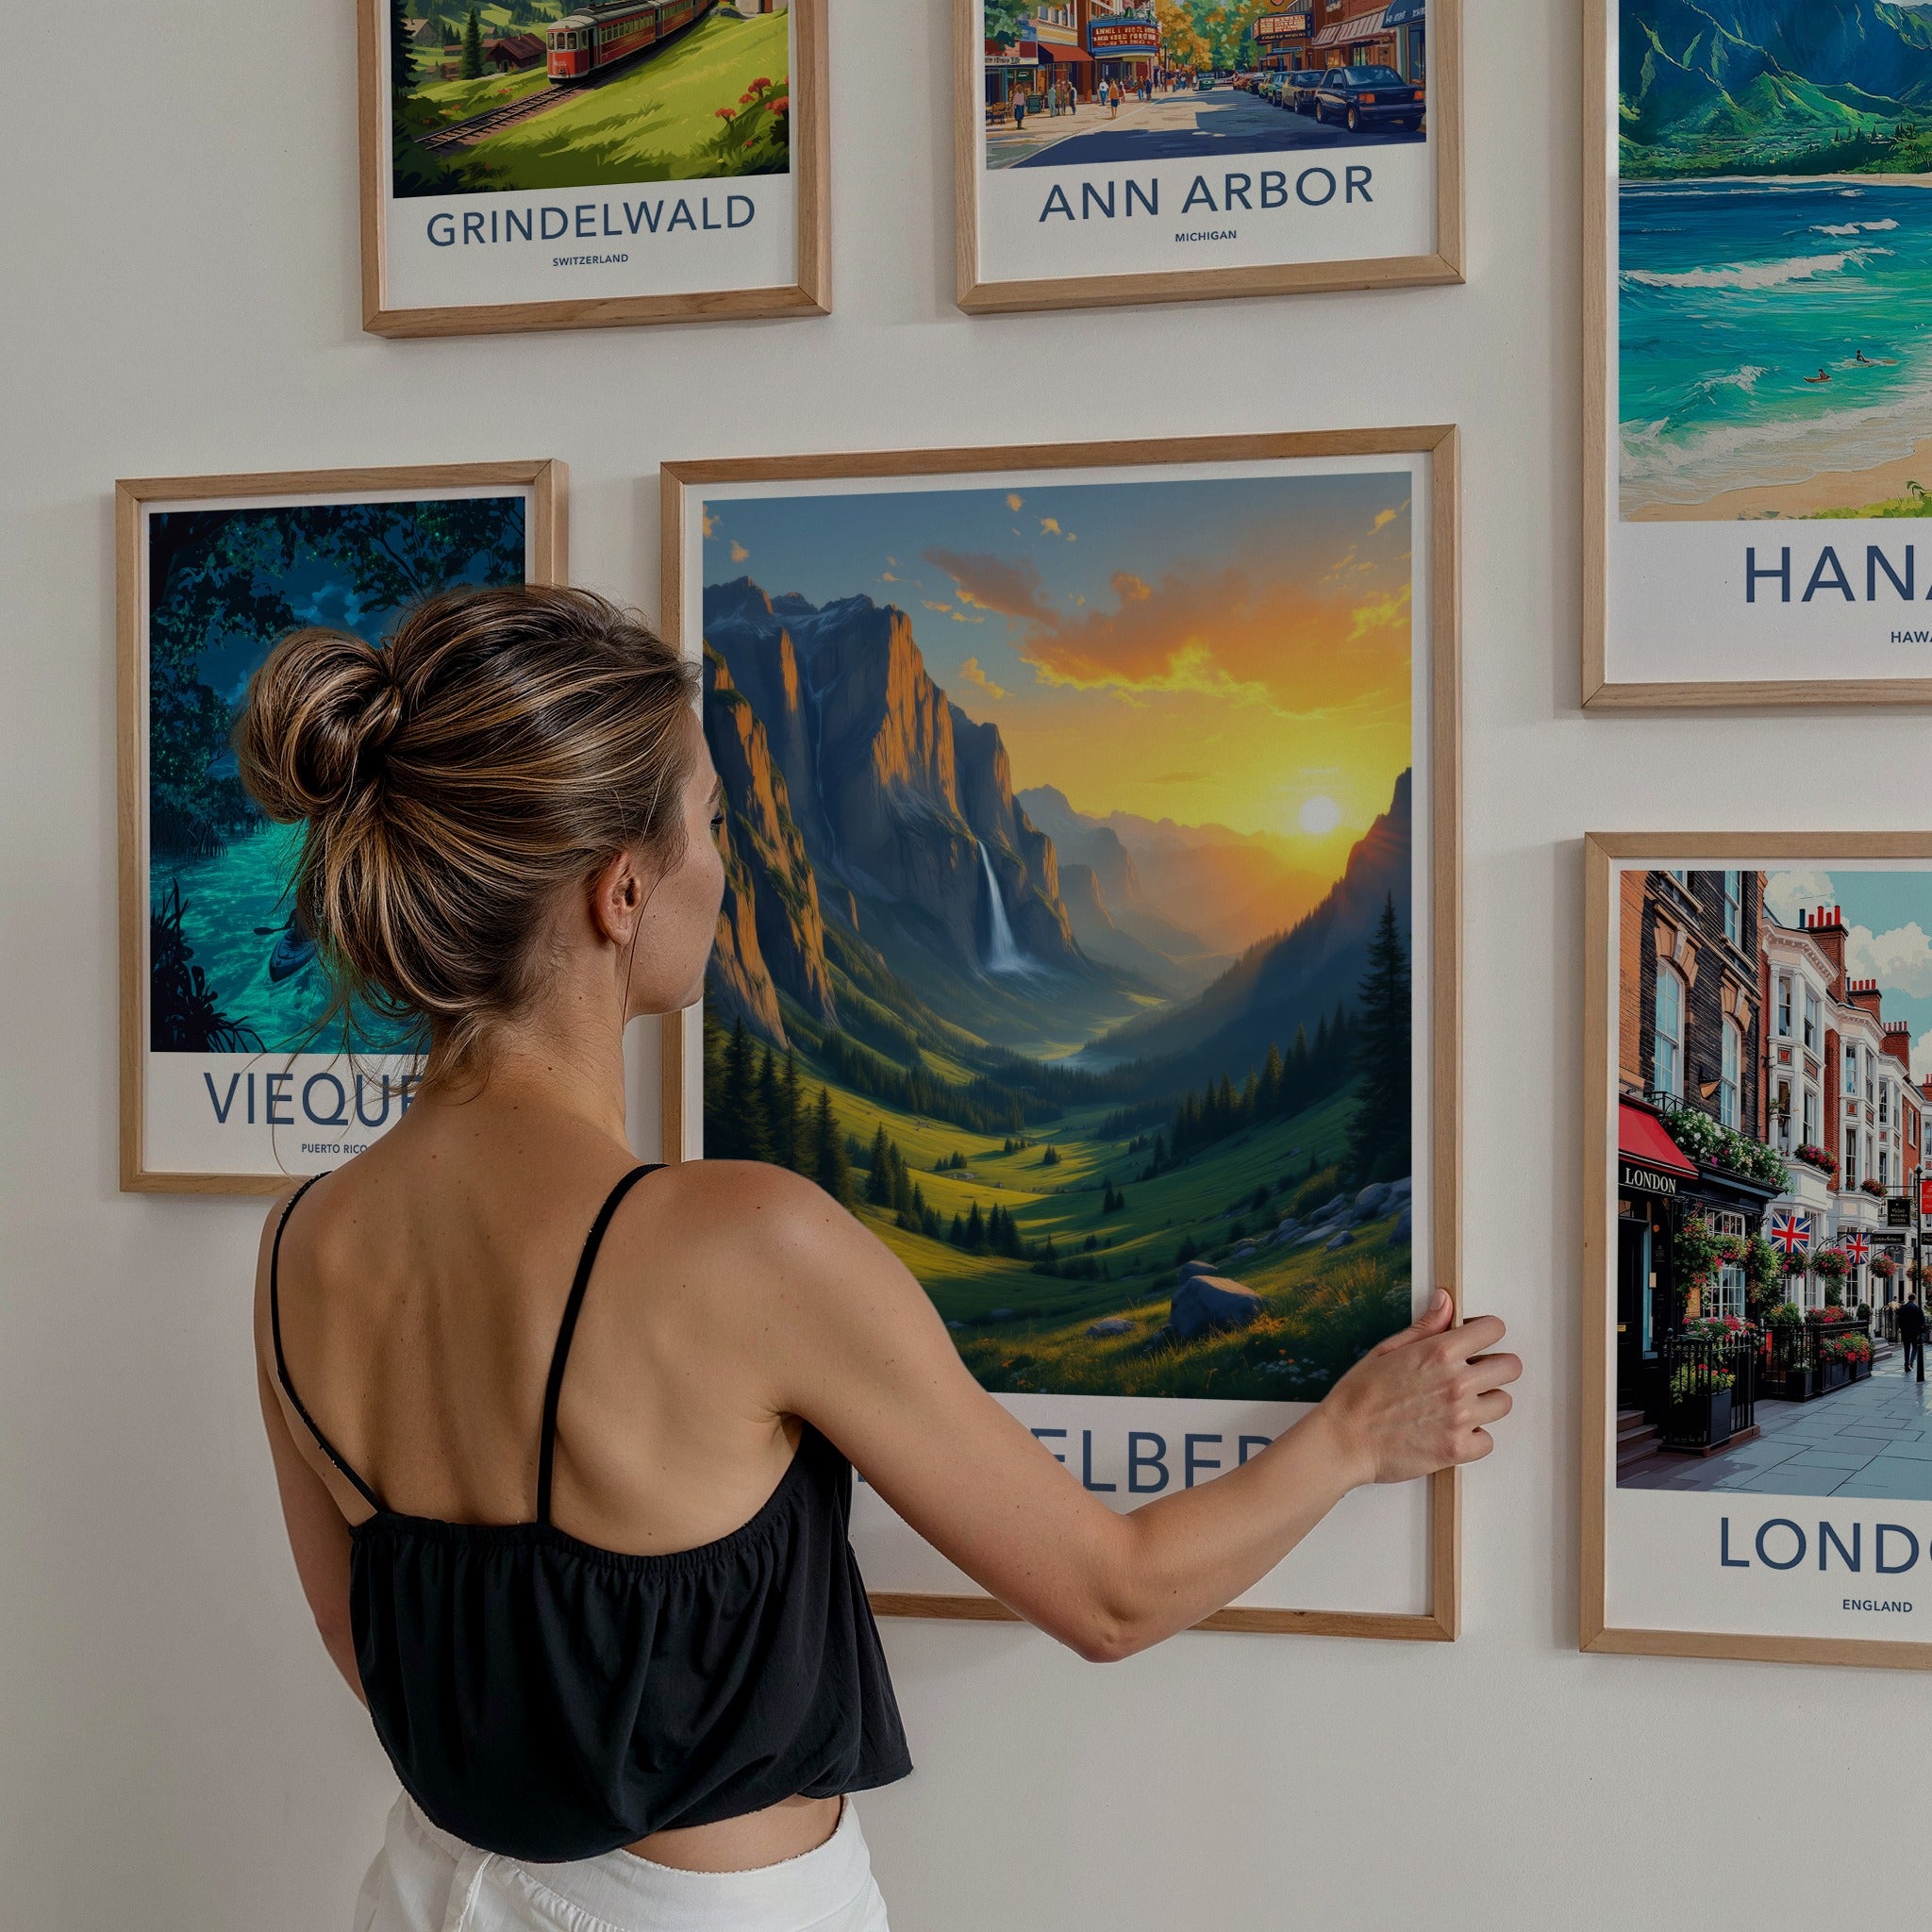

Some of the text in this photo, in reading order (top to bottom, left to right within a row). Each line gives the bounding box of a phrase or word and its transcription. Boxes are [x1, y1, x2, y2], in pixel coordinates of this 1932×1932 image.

[1039, 165, 1374, 223] ANN ARBOR
[426, 194, 756, 247] GRINDELWALD
[1174, 229, 1238, 242] MICHIGAN
[552, 253, 629, 267] SWITZERLAND
[1745, 544, 1932, 604] HAN
[1890, 630, 1932, 643] HAW
[301, 1143, 368, 1155] PUERTO RICO
[1624, 1167, 1676, 1194] LONDON
[1721, 1517, 1932, 1574] LOND
[1842, 1598, 1913, 1613] ENGLAND
